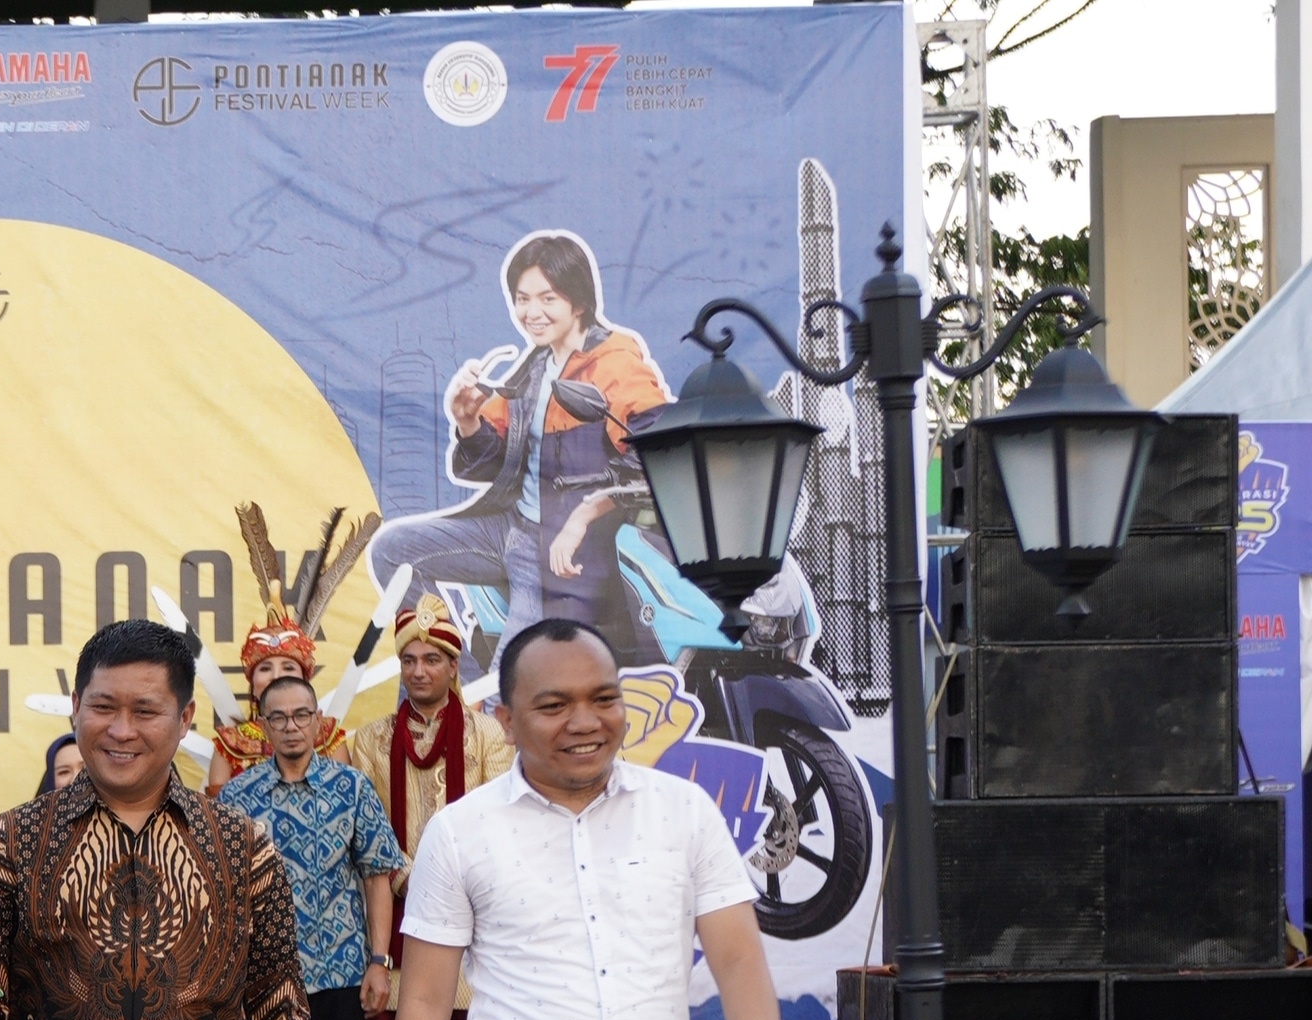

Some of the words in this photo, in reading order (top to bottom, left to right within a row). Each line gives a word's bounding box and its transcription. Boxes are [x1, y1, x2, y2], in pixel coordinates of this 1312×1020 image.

[626, 55, 667, 66] PULIH
[214, 63, 388, 89] PONTIANAK
[626, 69, 665, 81] LEBIH
[668, 68, 713, 80] CEPAT
[544, 45, 620, 122] 77
[626, 84, 687, 97] BANGKIT
[214, 93, 317, 110] FESTIVAL
[323, 91, 389, 109] WEEK
[626, 99, 665, 111] LEBIH
[668, 98, 705, 110] KUAT
[1240, 616, 1286, 640] AHA
